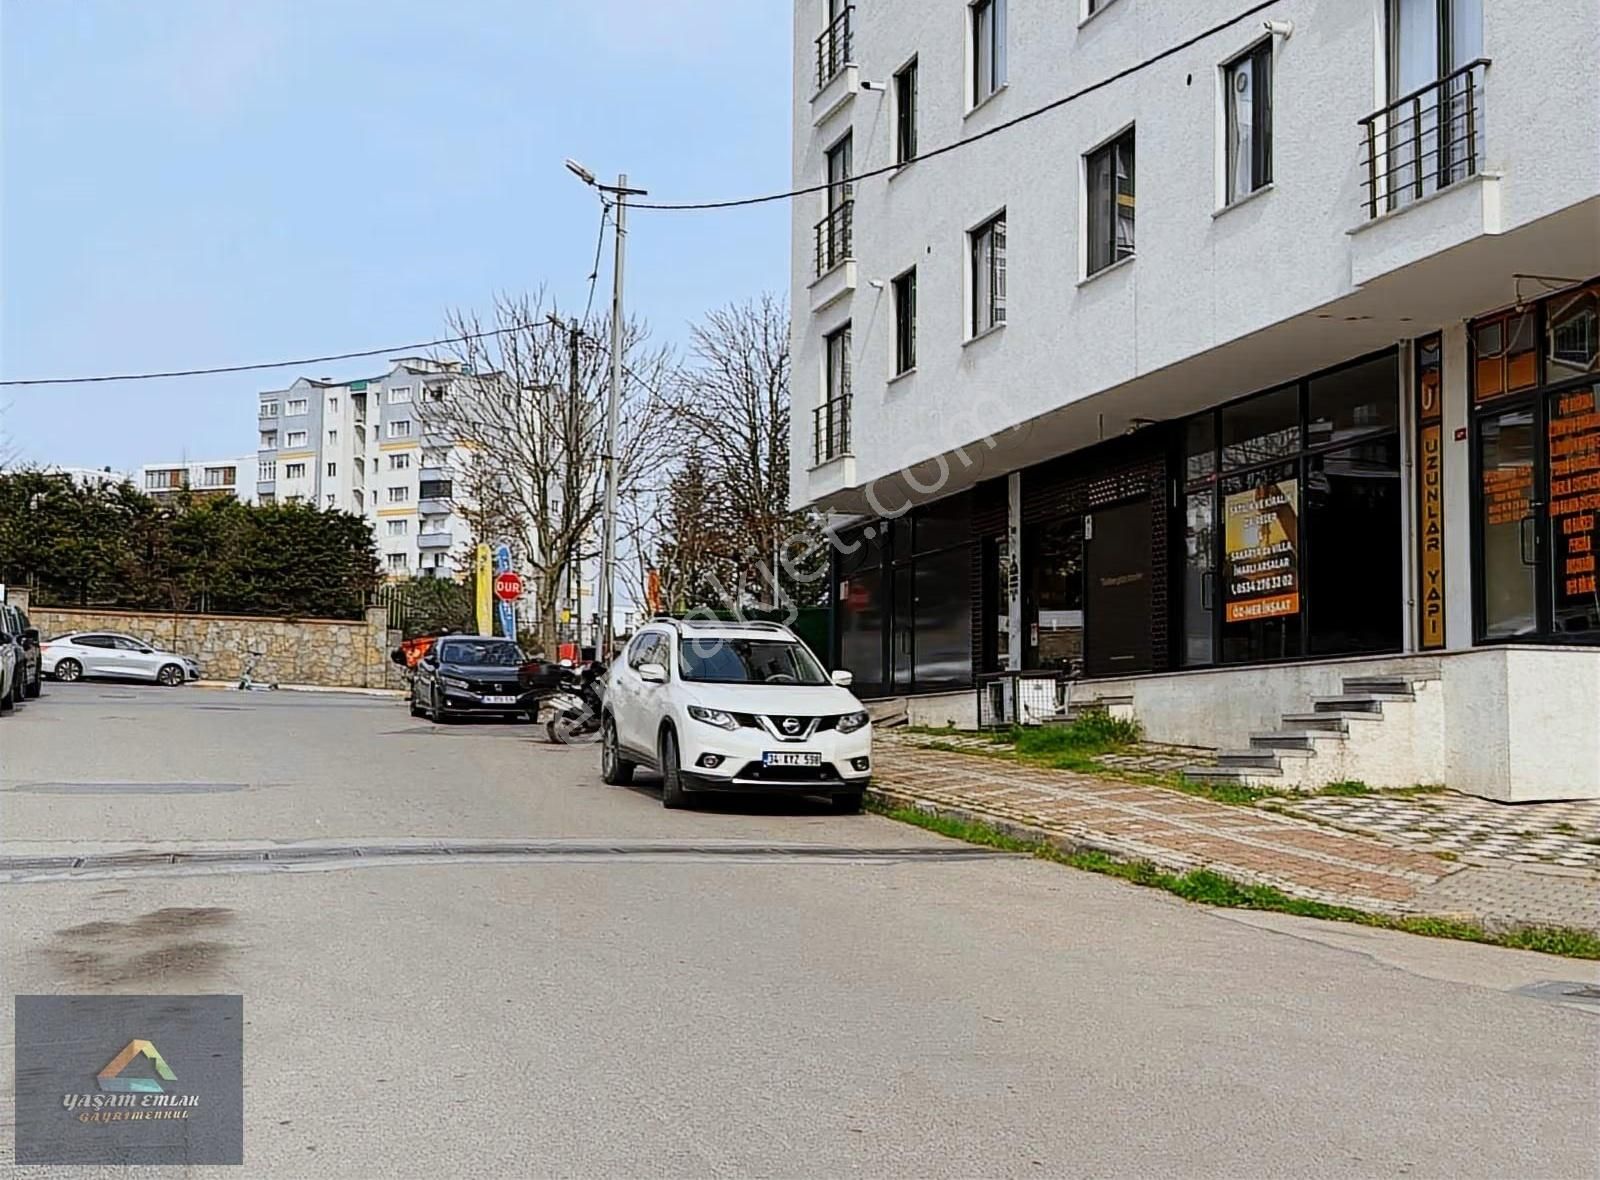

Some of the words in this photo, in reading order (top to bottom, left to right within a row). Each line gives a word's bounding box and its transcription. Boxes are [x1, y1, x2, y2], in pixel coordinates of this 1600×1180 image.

[1425, 439, 1440, 551] UZUNLAR
[496, 581, 520, 593] DUR
[1427, 569, 1441, 634] YAPI
